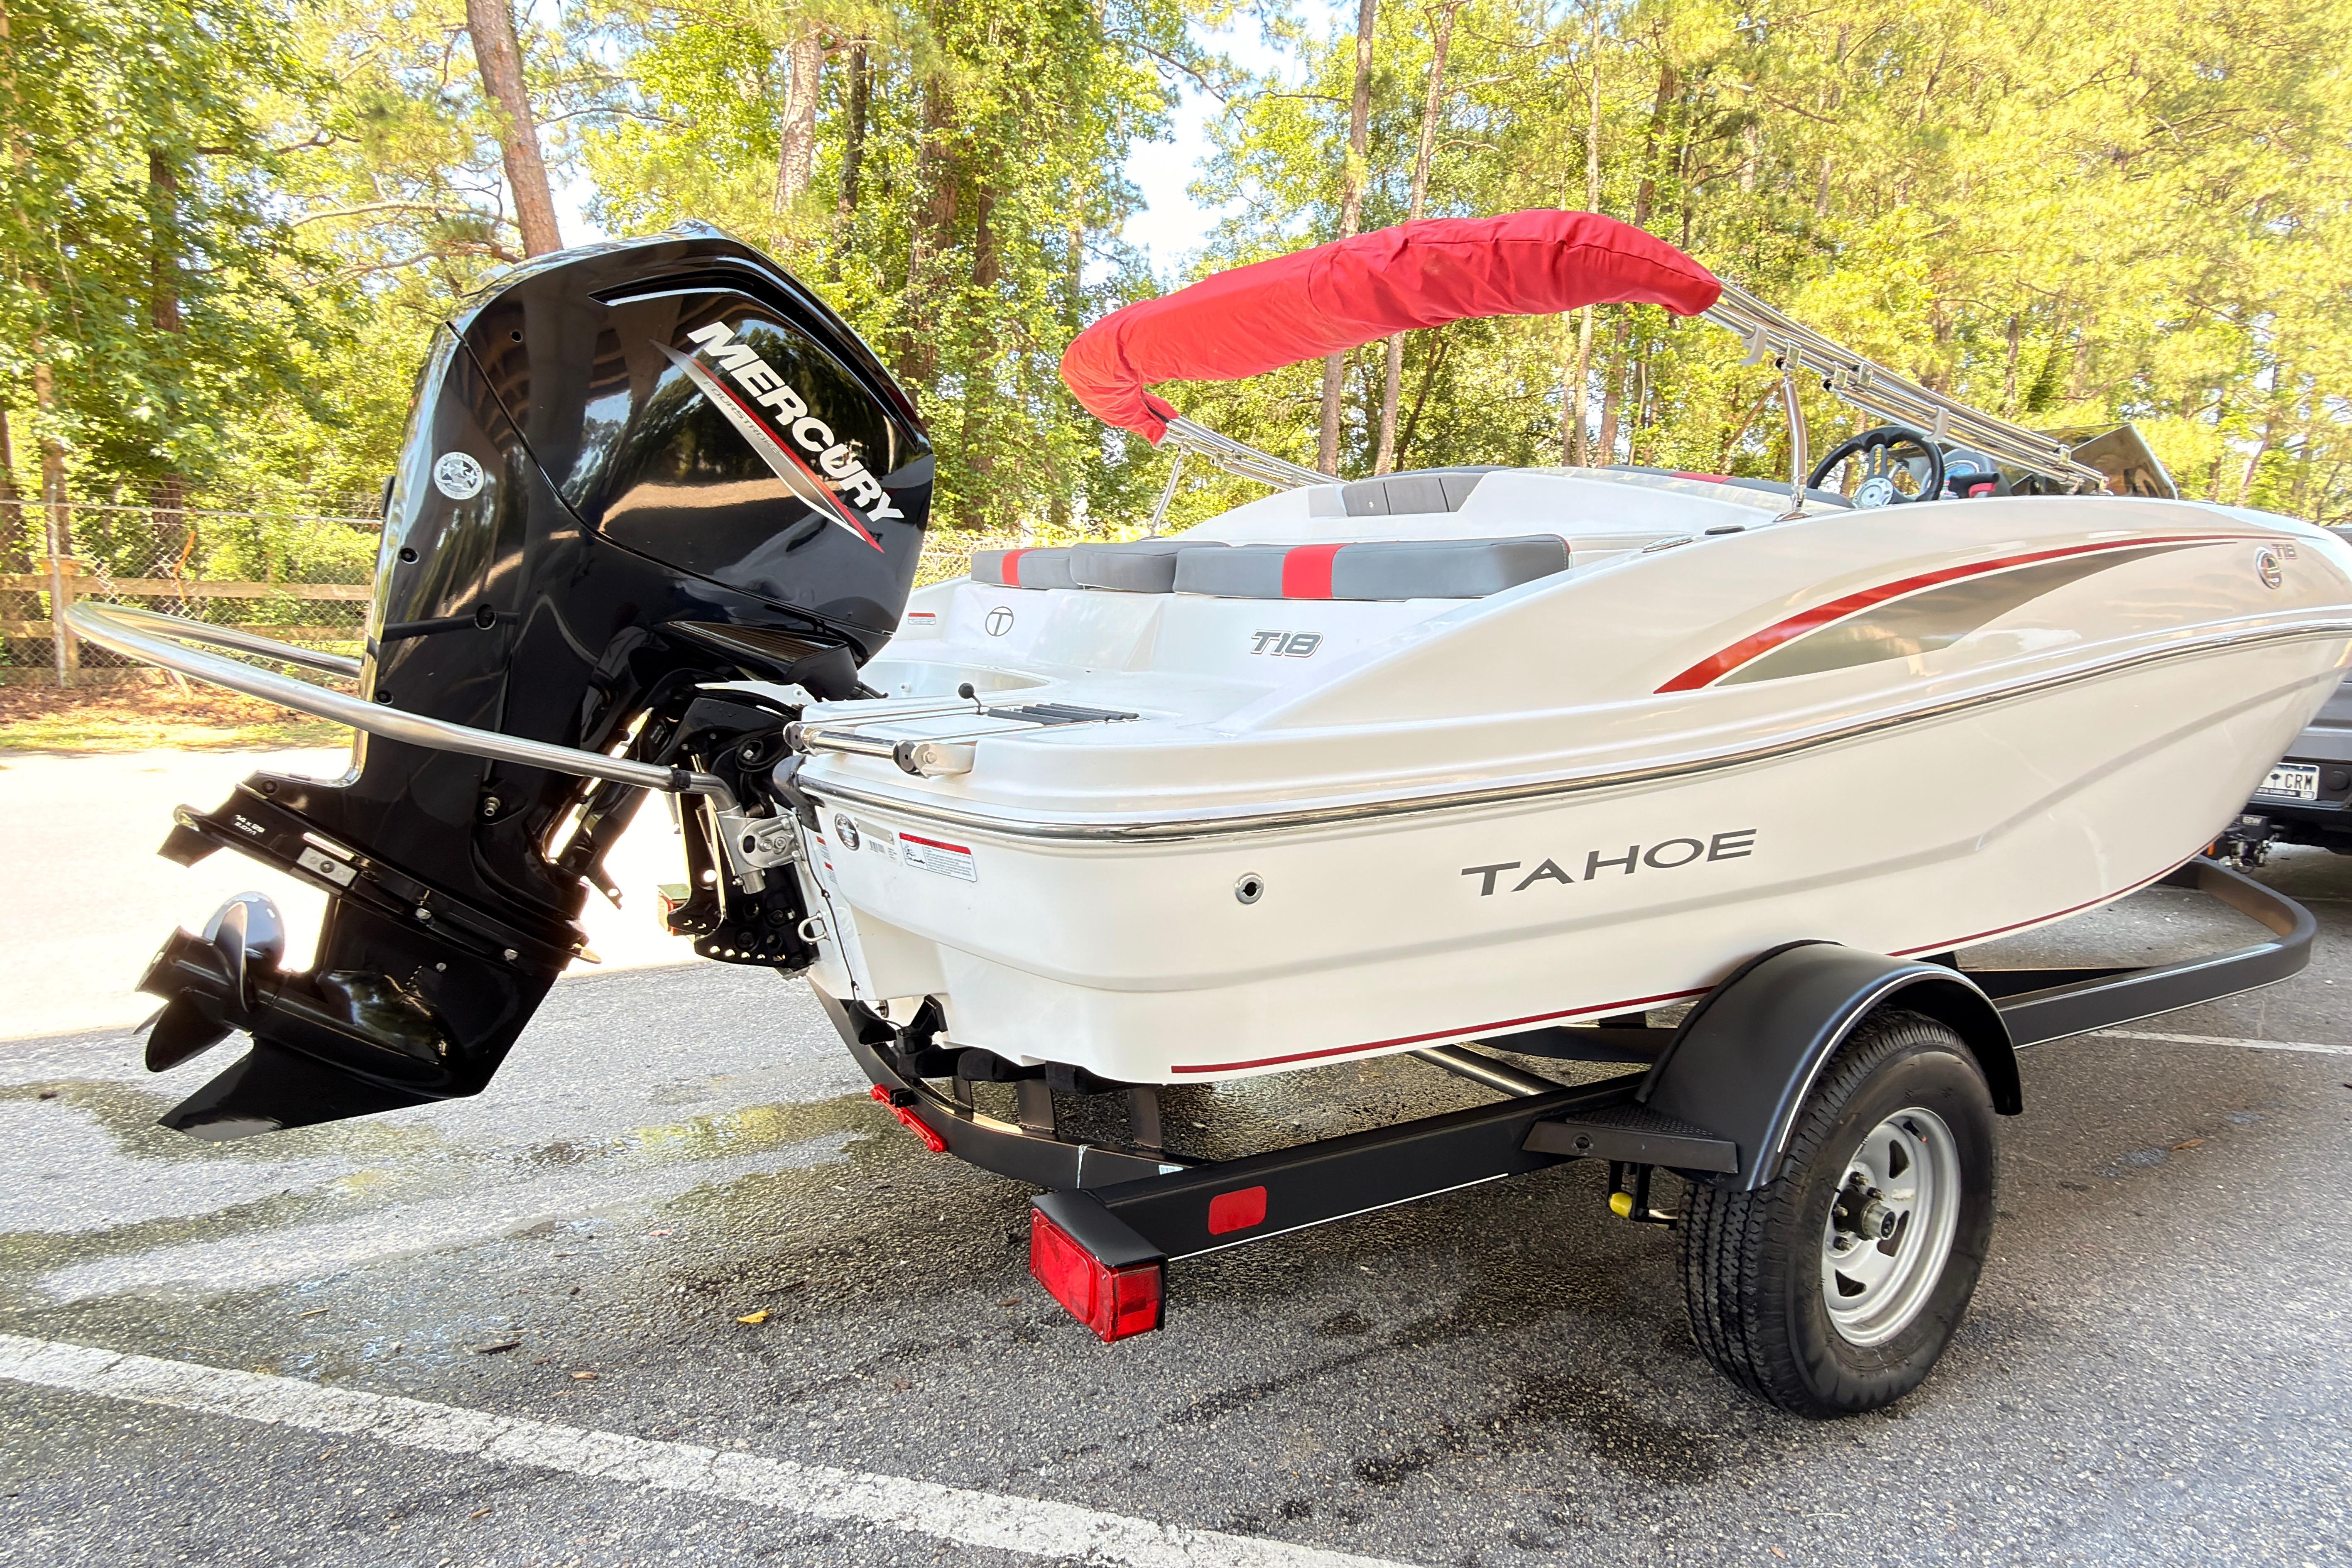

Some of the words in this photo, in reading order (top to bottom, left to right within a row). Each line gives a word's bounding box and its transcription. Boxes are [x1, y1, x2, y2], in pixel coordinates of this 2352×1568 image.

[687, 321, 904, 522] MERCURY
[703, 380, 780, 453] FOURSTROKE
[1250, 629, 1323, 658] T18
[2285, 773, 2313, 791] CRM
[1461, 828, 1757, 897] TAHOE
